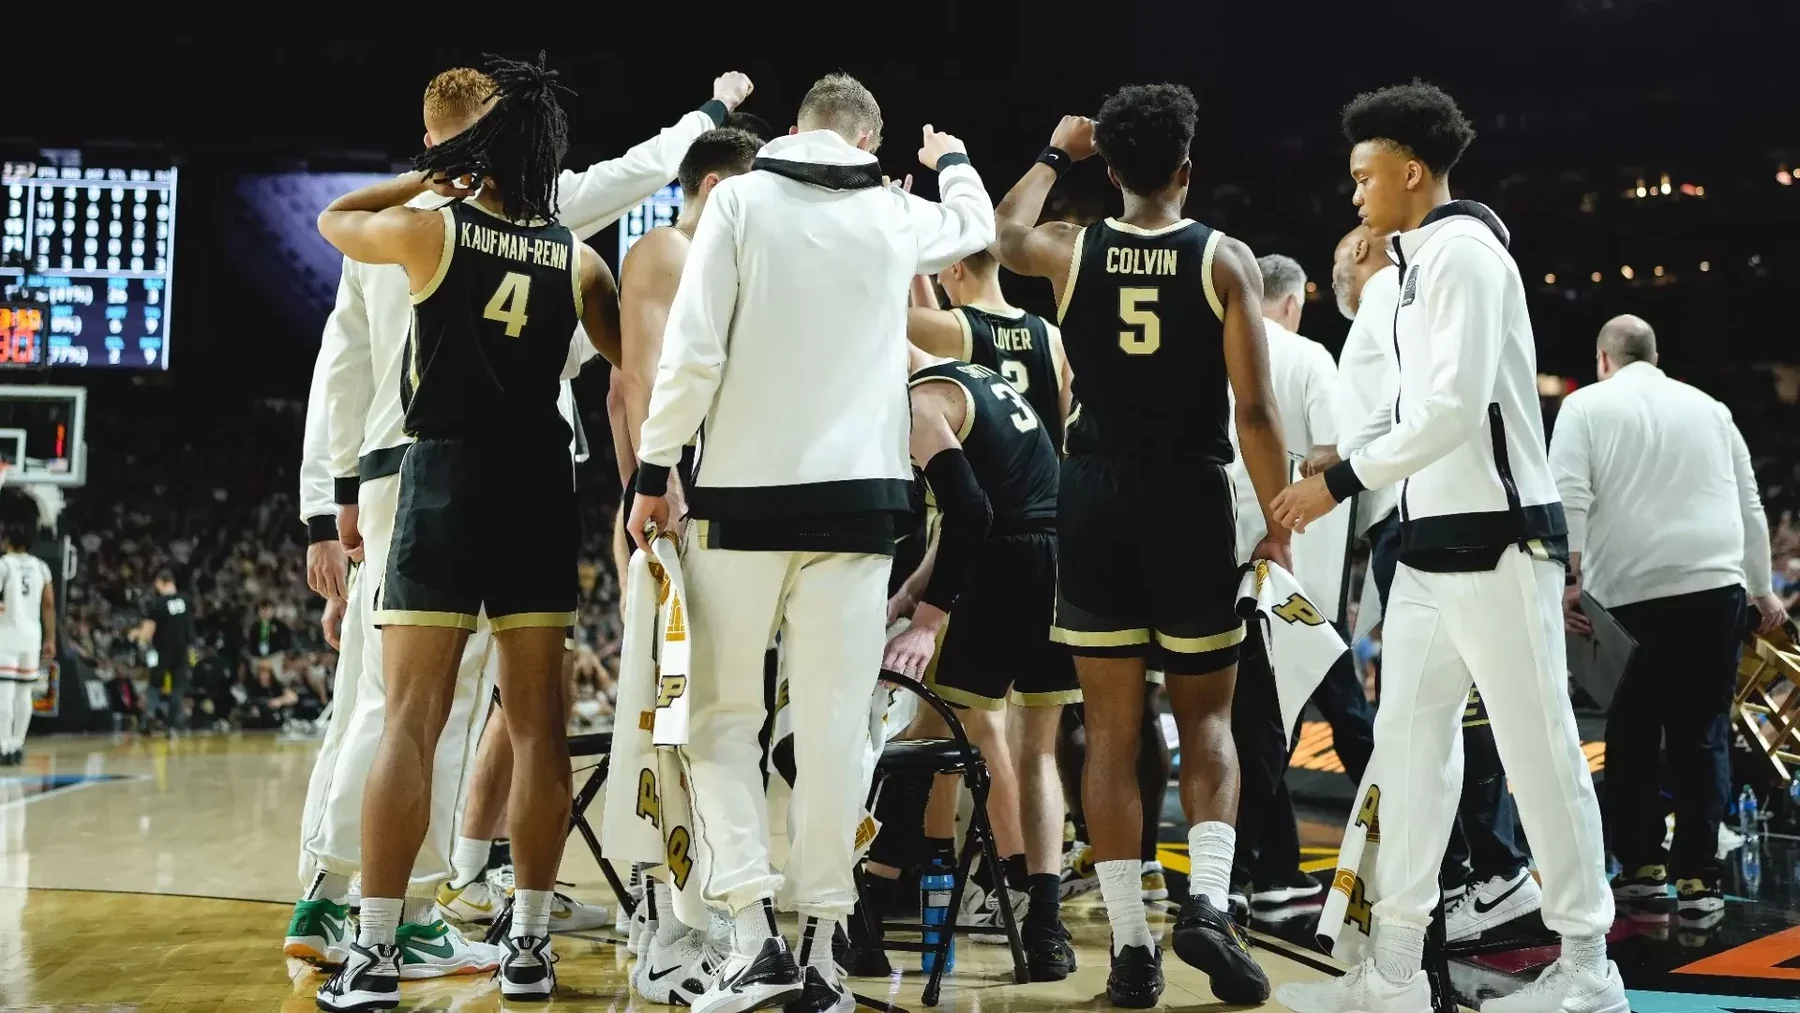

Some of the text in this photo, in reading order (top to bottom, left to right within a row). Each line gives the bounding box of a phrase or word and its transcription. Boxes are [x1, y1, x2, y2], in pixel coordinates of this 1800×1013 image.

[460, 222, 568, 270] KAUFMAN-RENN
[1106, 247, 1177, 276] COLVIN
[483, 271, 531, 338] 4
[1119, 287, 1160, 355] 5
[990, 383, 1038, 433] 3
[1271, 592, 1326, 626] P
[656, 674, 687, 708] P
[636, 767, 660, 830] P
[667, 825, 693, 892] P
